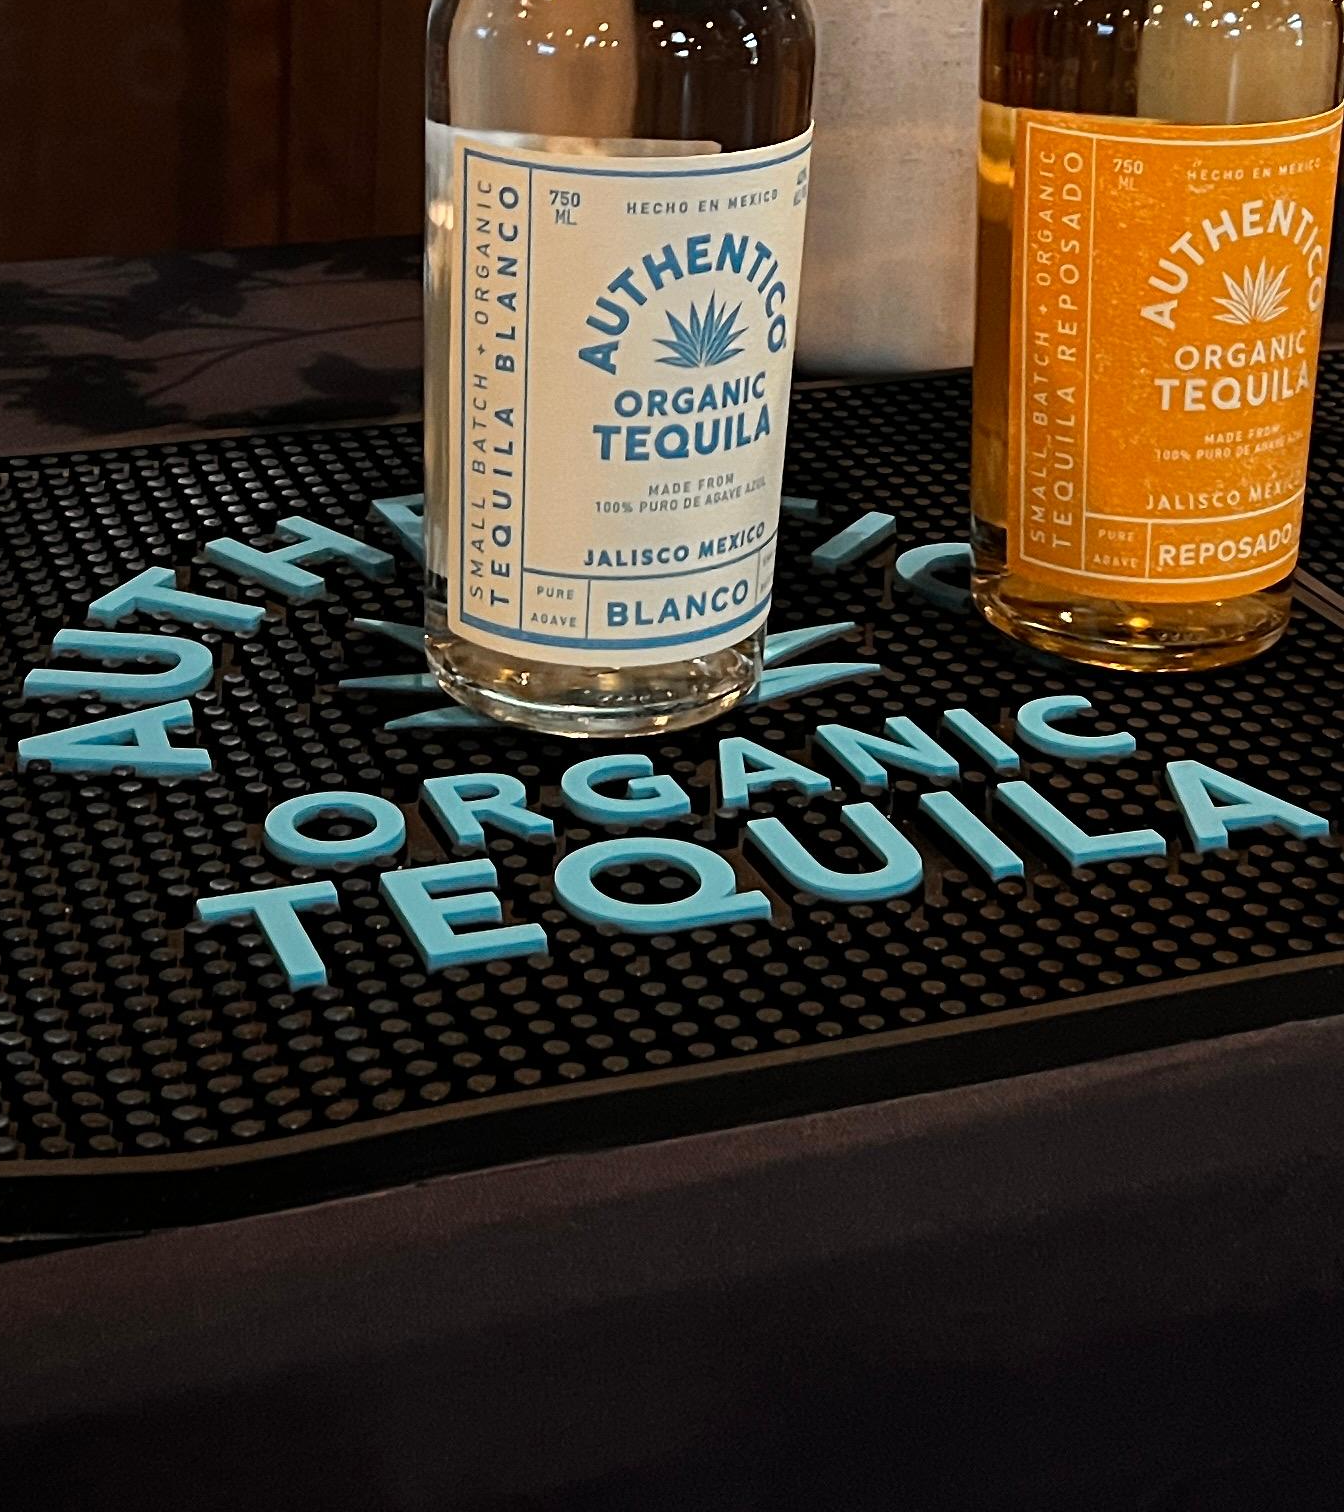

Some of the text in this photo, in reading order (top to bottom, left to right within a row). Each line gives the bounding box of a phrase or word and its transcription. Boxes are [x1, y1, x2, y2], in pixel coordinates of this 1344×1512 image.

[1113, 158, 1144, 175] 750
[549, 190, 581, 207] 750
[554, 210, 577, 225] ML
[626, 188, 778, 215] HECHO EN MEXICO
[1139, 199, 1324, 331] AUTHENTICO
[578, 232, 788, 376] AUTHENTICO
[1030, 150, 1057, 544] SMALL BATCH ORGANIC
[1052, 151, 1084, 548] TEQUILA REPOSADO
[1174, 329, 1306, 371] ORGANIC
[469, 179, 492, 601] SMALL BATCH ORGANIC
[490, 185, 520, 607] TEQUILA BLANCO
[613, 370, 767, 418] ORGANIC
[1154, 363, 1311, 413] TEQUILA
[592, 404, 771, 461] TEQUILA
[595, 501, 633, 514] 100%
[639, 499, 679, 513] PURO
[683, 496, 701, 510] DE
[648, 472, 735, 497] MADE FROM
[1145, 489, 1241, 512] JALISCO
[584, 521, 766, 567] JALISCO MEXICO
[1157, 522, 1293, 568] REPOSADO
[536, 585, 574, 600] PURE
[606, 579, 750, 627] BLANCO
[530, 612, 578, 628] AGAVE
[264, 695, 1136, 866] ORGANIC
[196, 758, 1330, 990] TEQUILA
